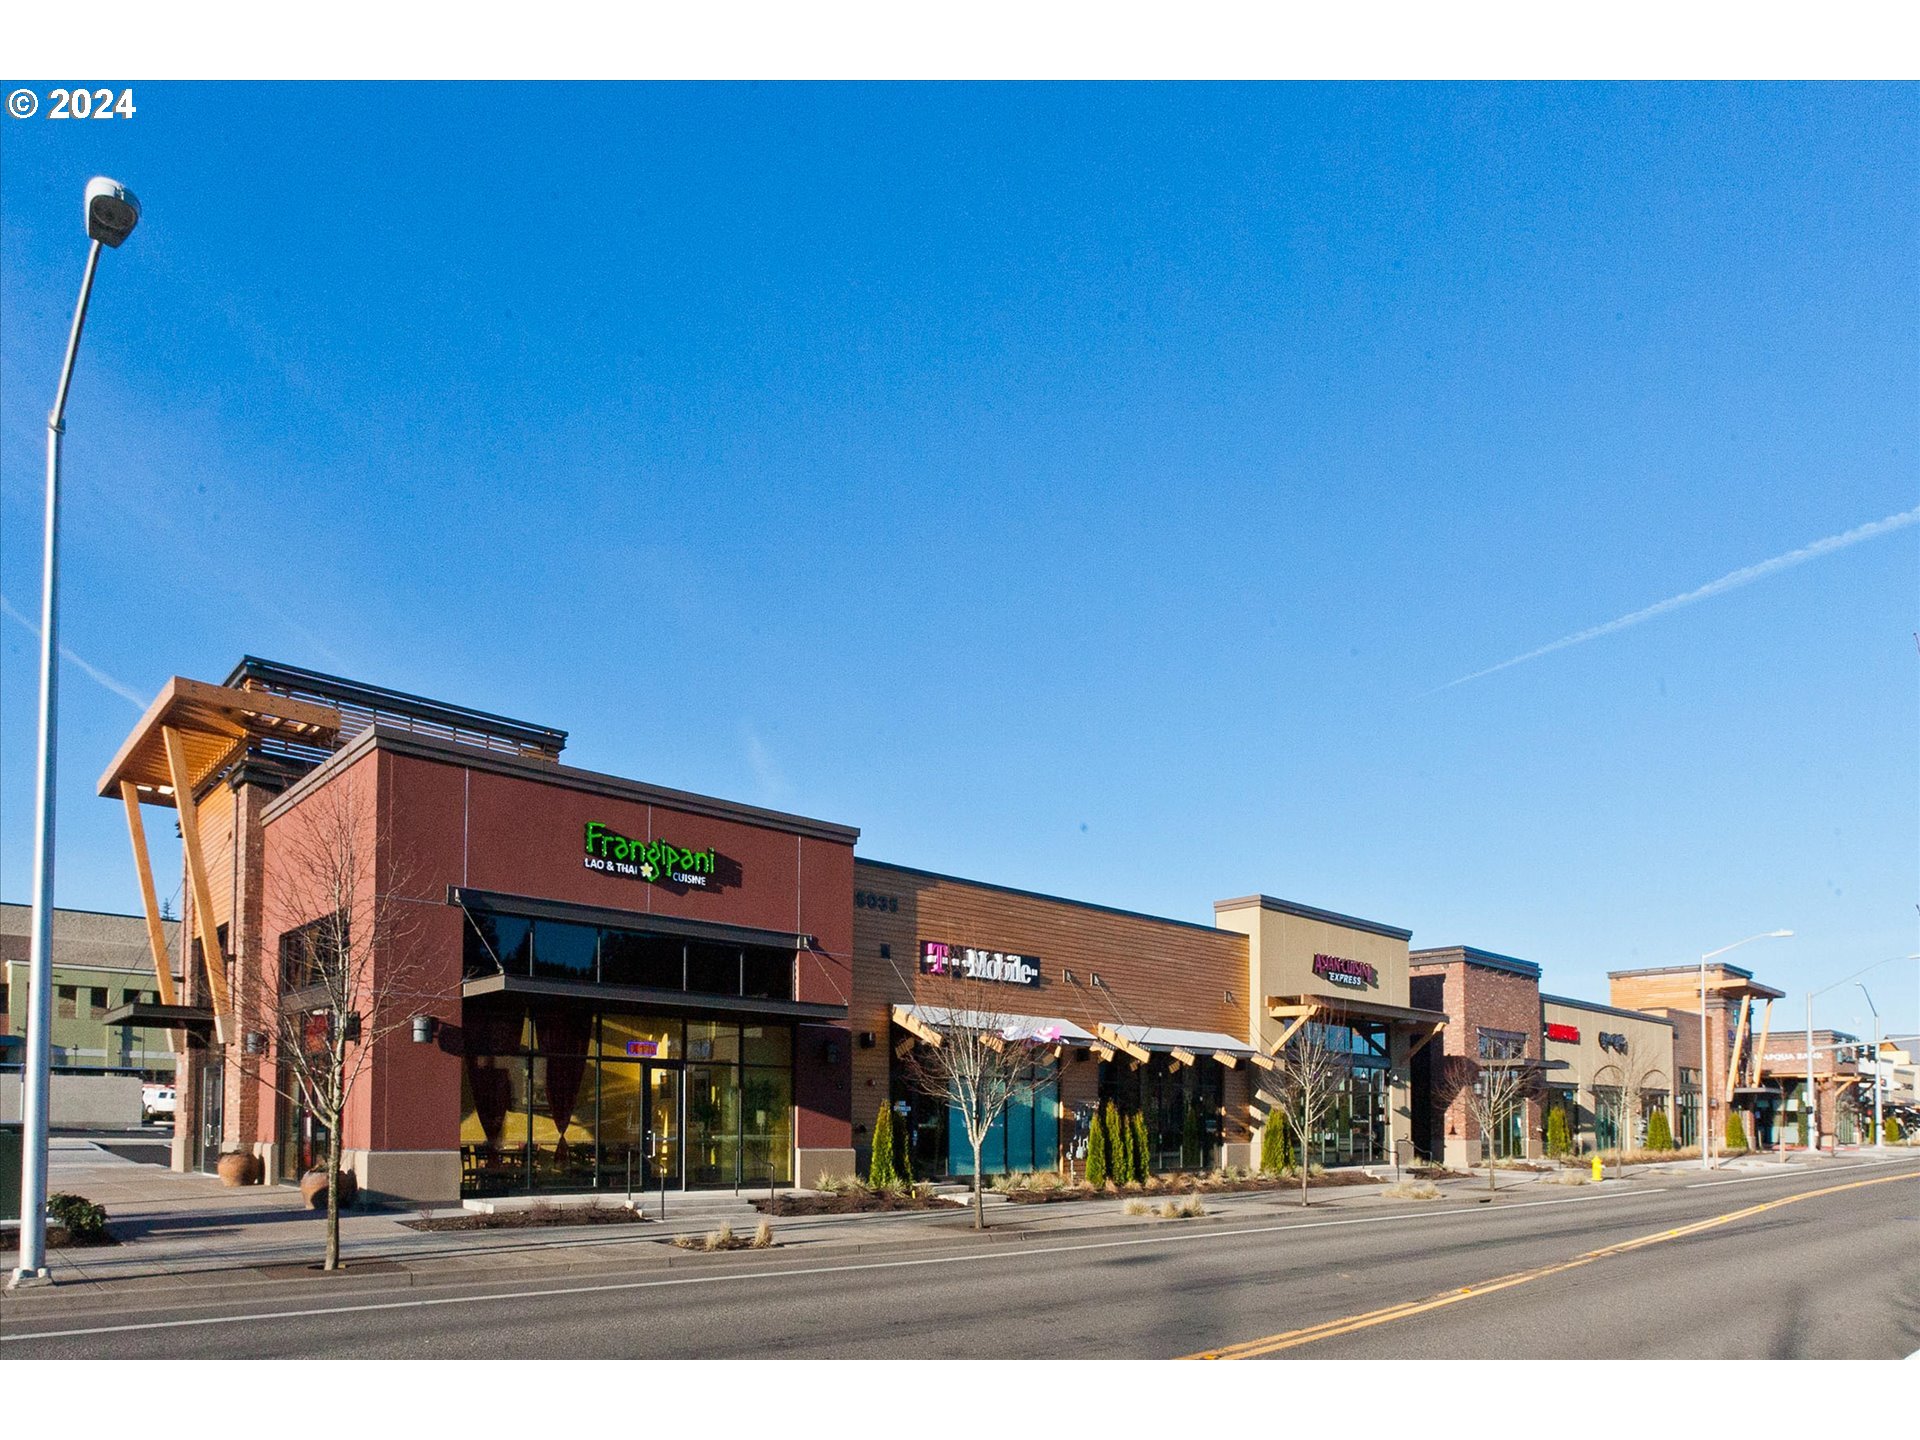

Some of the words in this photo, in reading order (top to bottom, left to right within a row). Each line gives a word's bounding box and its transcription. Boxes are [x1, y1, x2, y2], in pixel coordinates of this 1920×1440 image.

[584, 822, 715, 882] Frangipani
[584, 857, 605, 870] LAO
[606, 861, 614, 871] &
[616, 862, 638, 875] THAI
[672, 872, 706, 886] CUISINE
[1315, 953, 1341, 973] ASIAN
[1341, 958, 1374, 982] CUISINE
[1329, 972, 1362, 985] EXPRESS
